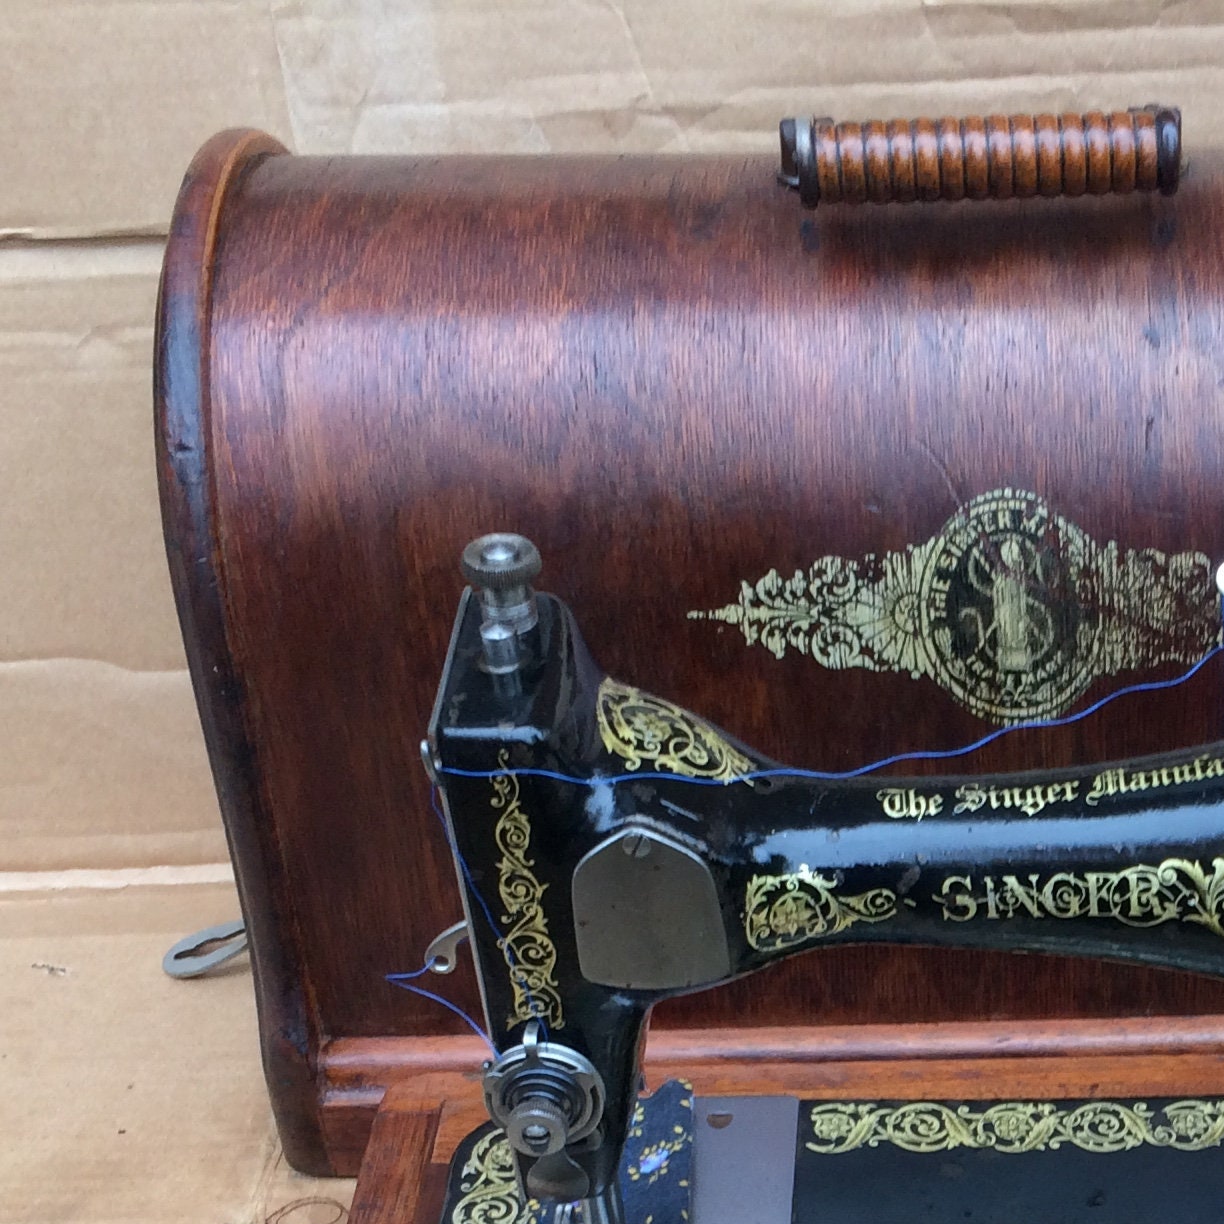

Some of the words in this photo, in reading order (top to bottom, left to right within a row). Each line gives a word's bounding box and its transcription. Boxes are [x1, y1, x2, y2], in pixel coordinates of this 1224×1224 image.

[876, 787, 944, 822] The
[953, 779, 1080, 817] Singer
[941, 871, 1170, 922] SINGER
